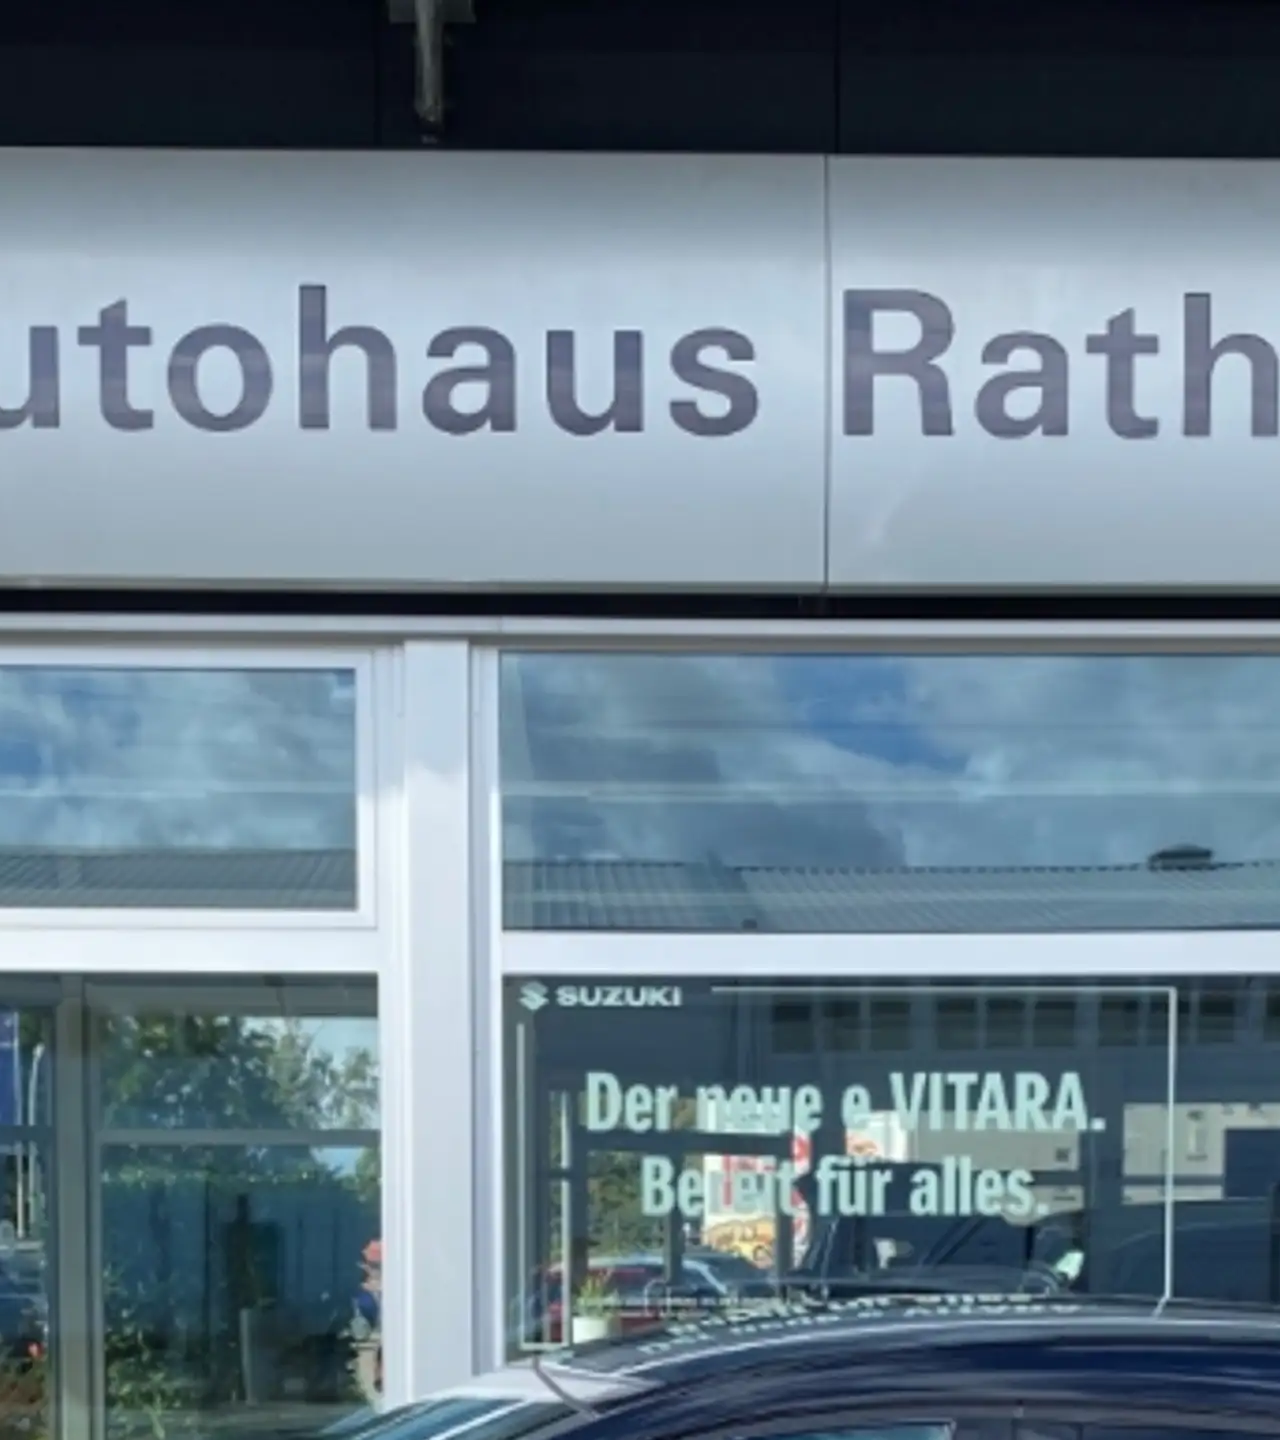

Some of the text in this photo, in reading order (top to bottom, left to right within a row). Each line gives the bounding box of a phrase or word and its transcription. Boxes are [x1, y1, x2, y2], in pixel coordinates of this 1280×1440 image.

[556, 985, 681, 1007] SUZUKI
[586, 1072, 1105, 1133] Der neue e VITARA.
[641, 1156, 796, 1217] Bereit
[816, 1156, 893, 1217] für
[909, 1156, 1051, 1217] alles.
